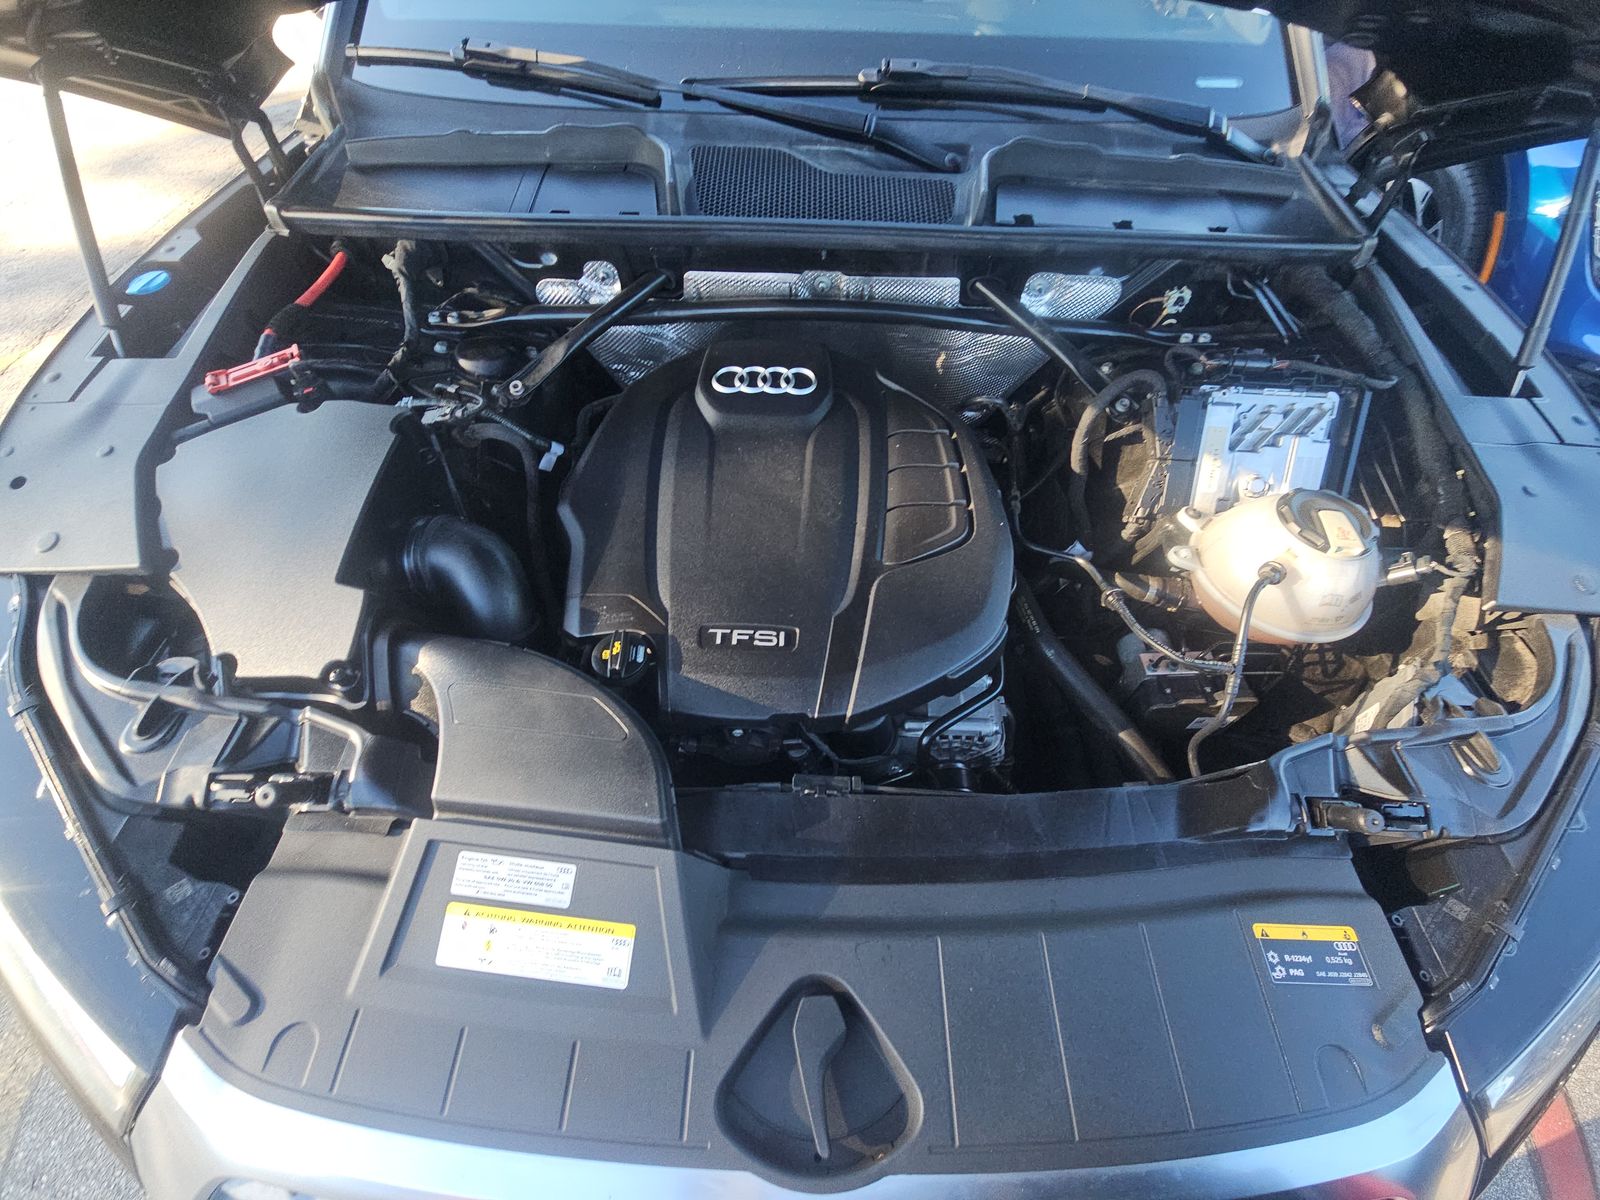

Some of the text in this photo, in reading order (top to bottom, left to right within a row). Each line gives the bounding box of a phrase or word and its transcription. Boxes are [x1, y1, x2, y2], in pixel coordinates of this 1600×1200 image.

[708, 628, 785, 647] TFSI
[566, 922, 615, 935] ATTENTION
[1289, 968, 1305, 977] PAG
